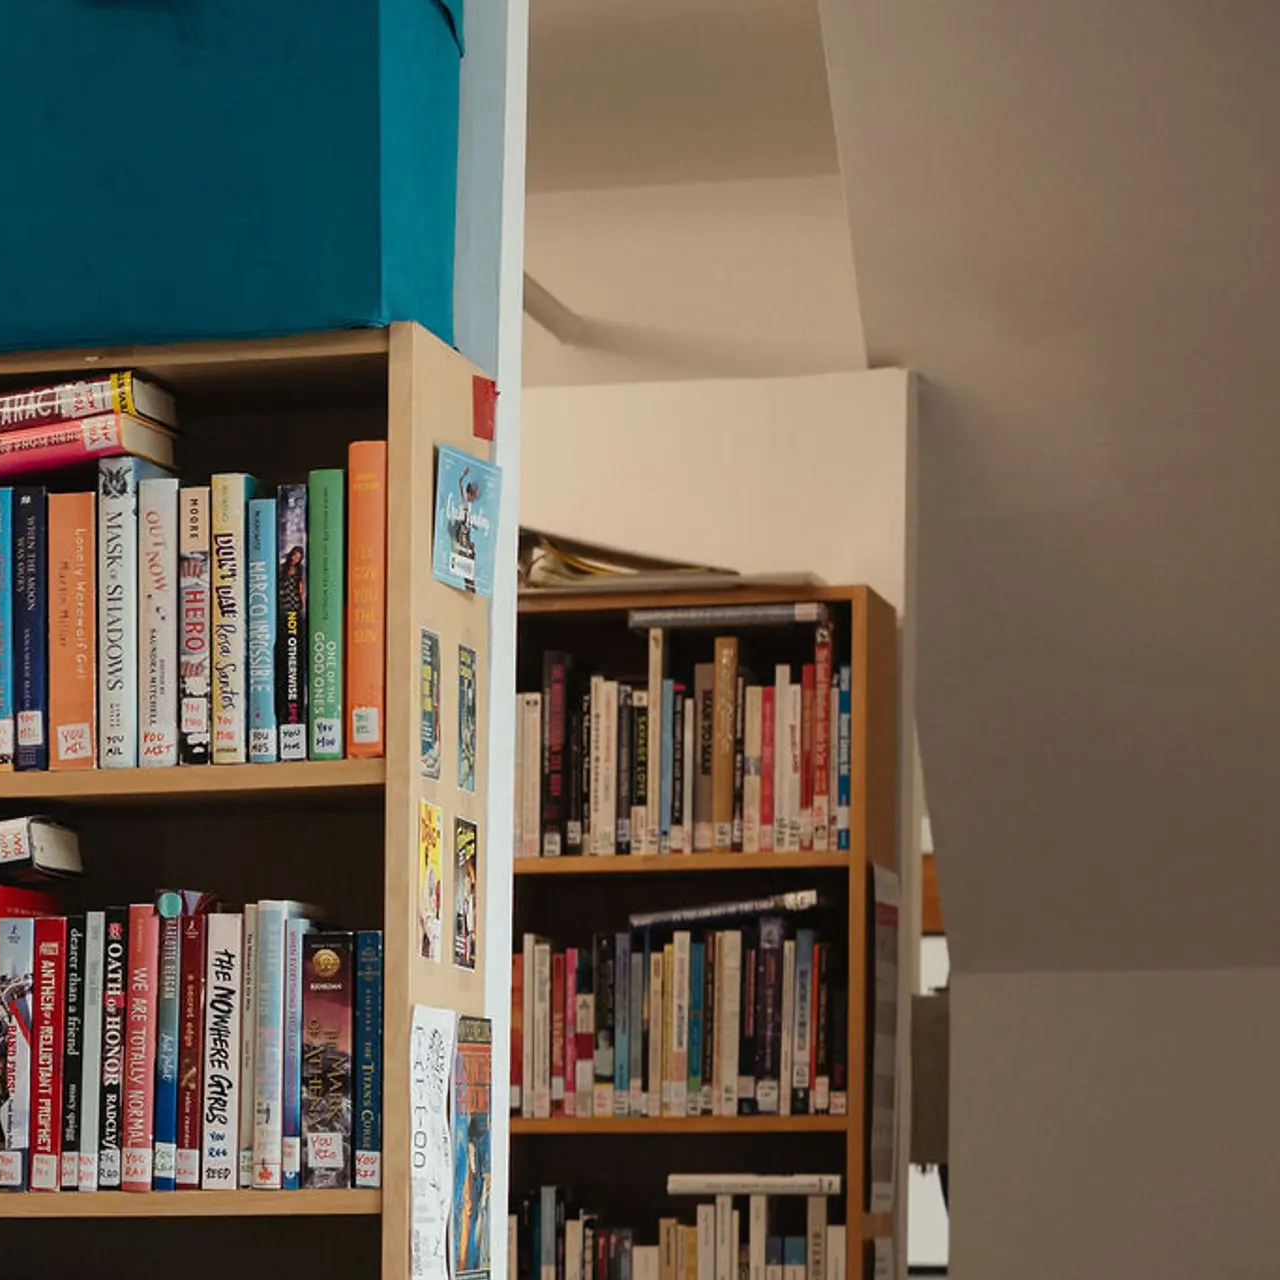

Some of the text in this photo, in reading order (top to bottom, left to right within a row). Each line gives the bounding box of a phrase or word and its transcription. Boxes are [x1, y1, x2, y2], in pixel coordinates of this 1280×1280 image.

[144, 511, 168, 594] OUT NOW
[106, 511, 124, 692] MASK SHADOWS
[184, 589, 206, 652] HERO
[288, 610, 298, 700] NOT OTHERWISE
[314, 631, 326, 714] GOOD ONES
[128, 966, 148, 1148] WE ARE TOTALLY NORMAL
